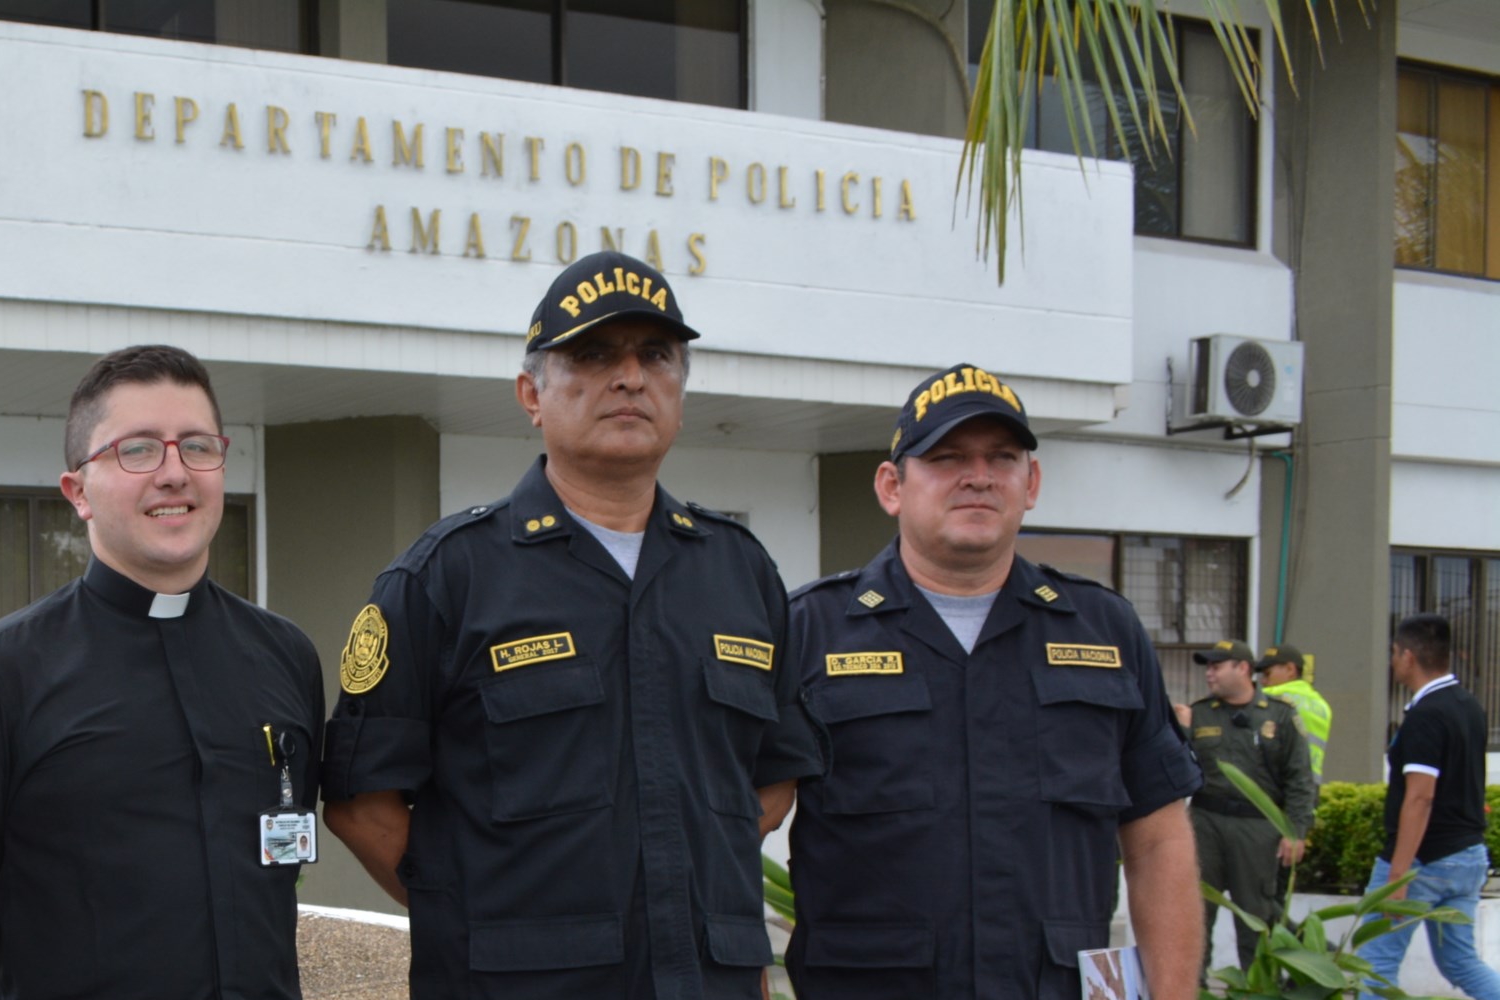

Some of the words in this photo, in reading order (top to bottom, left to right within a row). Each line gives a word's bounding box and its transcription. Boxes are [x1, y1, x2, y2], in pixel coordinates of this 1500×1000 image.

[81, 89, 586, 187] DEPARTAMENTO
[620, 147, 675, 197] DE
[709, 156, 916, 221] POLICIA
[366, 204, 706, 277] AMAZONAS
[559, 267, 667, 318] POLICIA
[914, 367, 1021, 422] POLICIA
[508, 651, 539, 663] GENERAL
[514, 640, 551, 655] ROJAS
[845, 656, 883, 665] GARCIA
